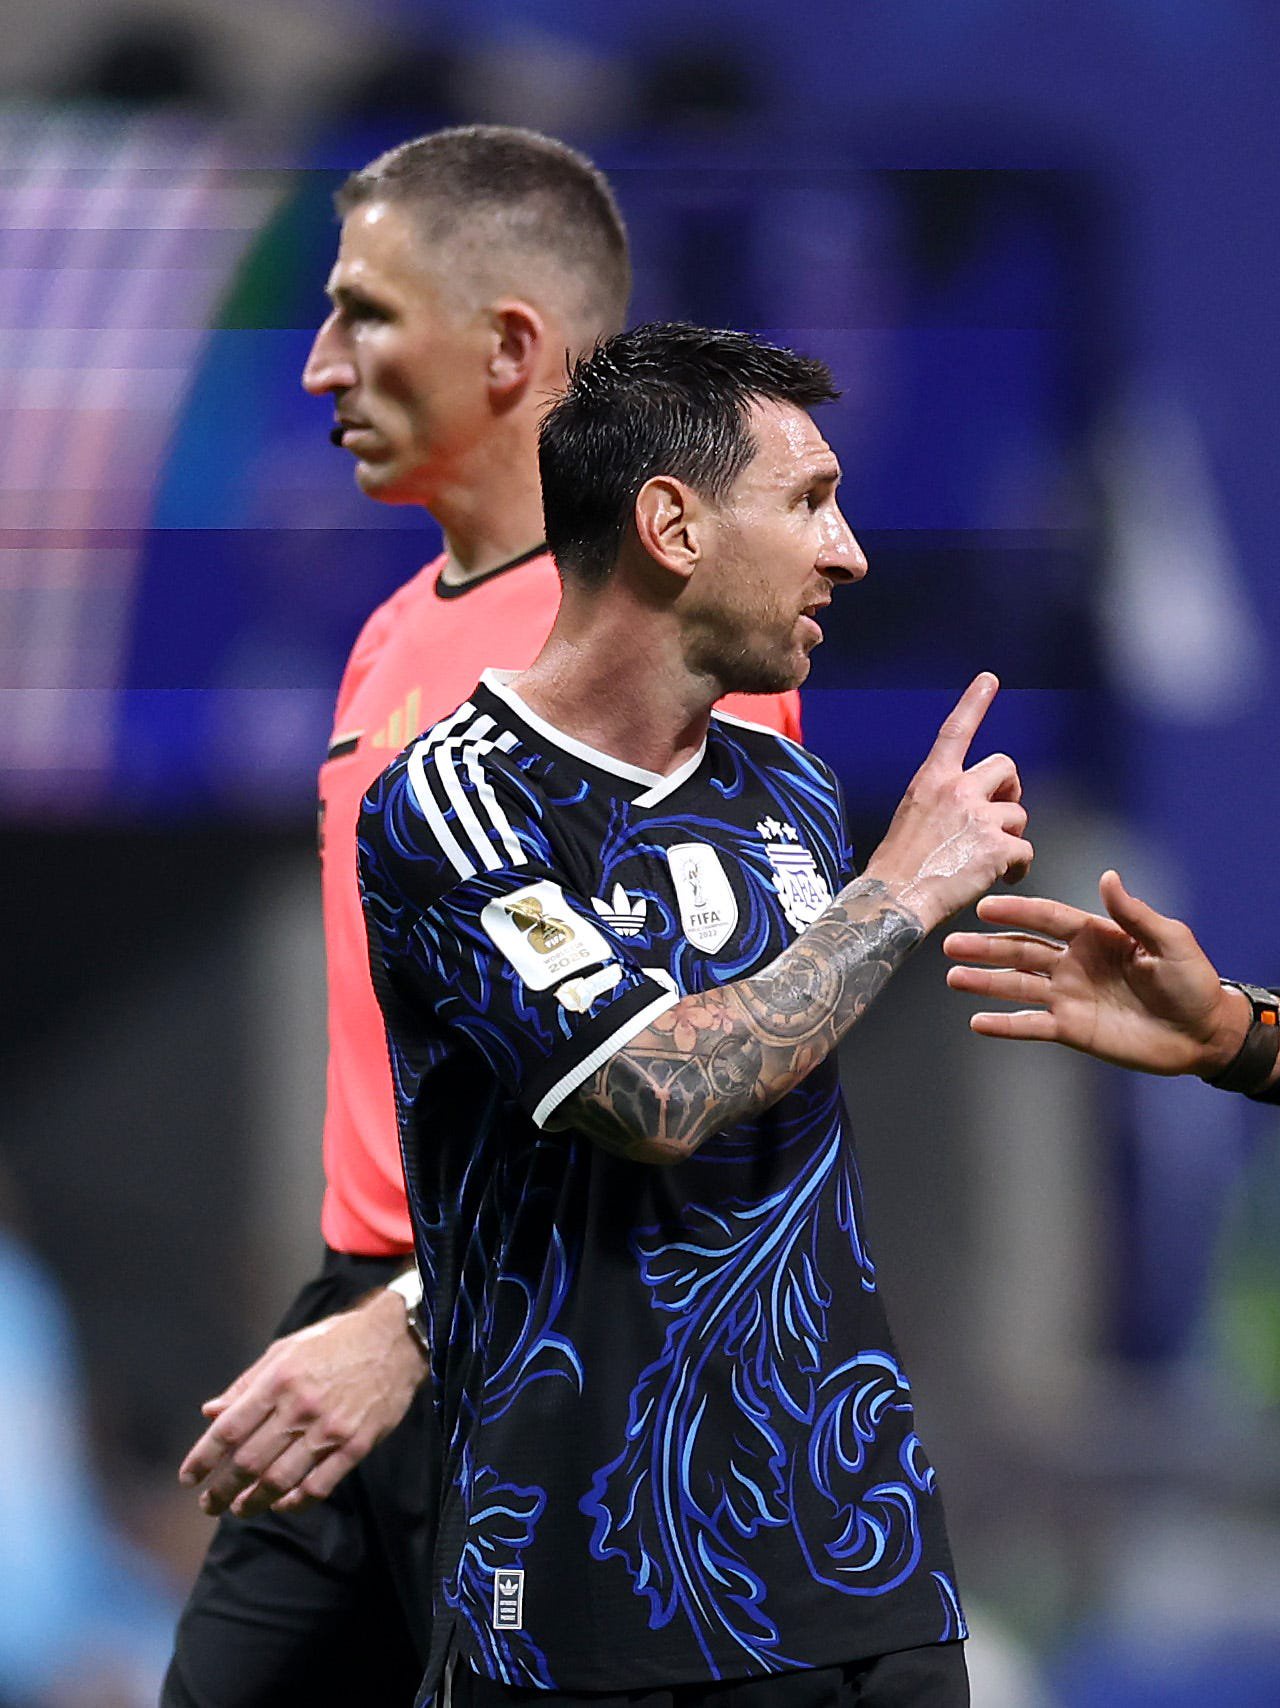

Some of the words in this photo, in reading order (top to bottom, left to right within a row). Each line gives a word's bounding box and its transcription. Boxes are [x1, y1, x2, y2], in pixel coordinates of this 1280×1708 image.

[787, 869, 822, 911] AFA
[690, 911, 720, 927] FIFA
[547, 948, 591, 974] 2026
